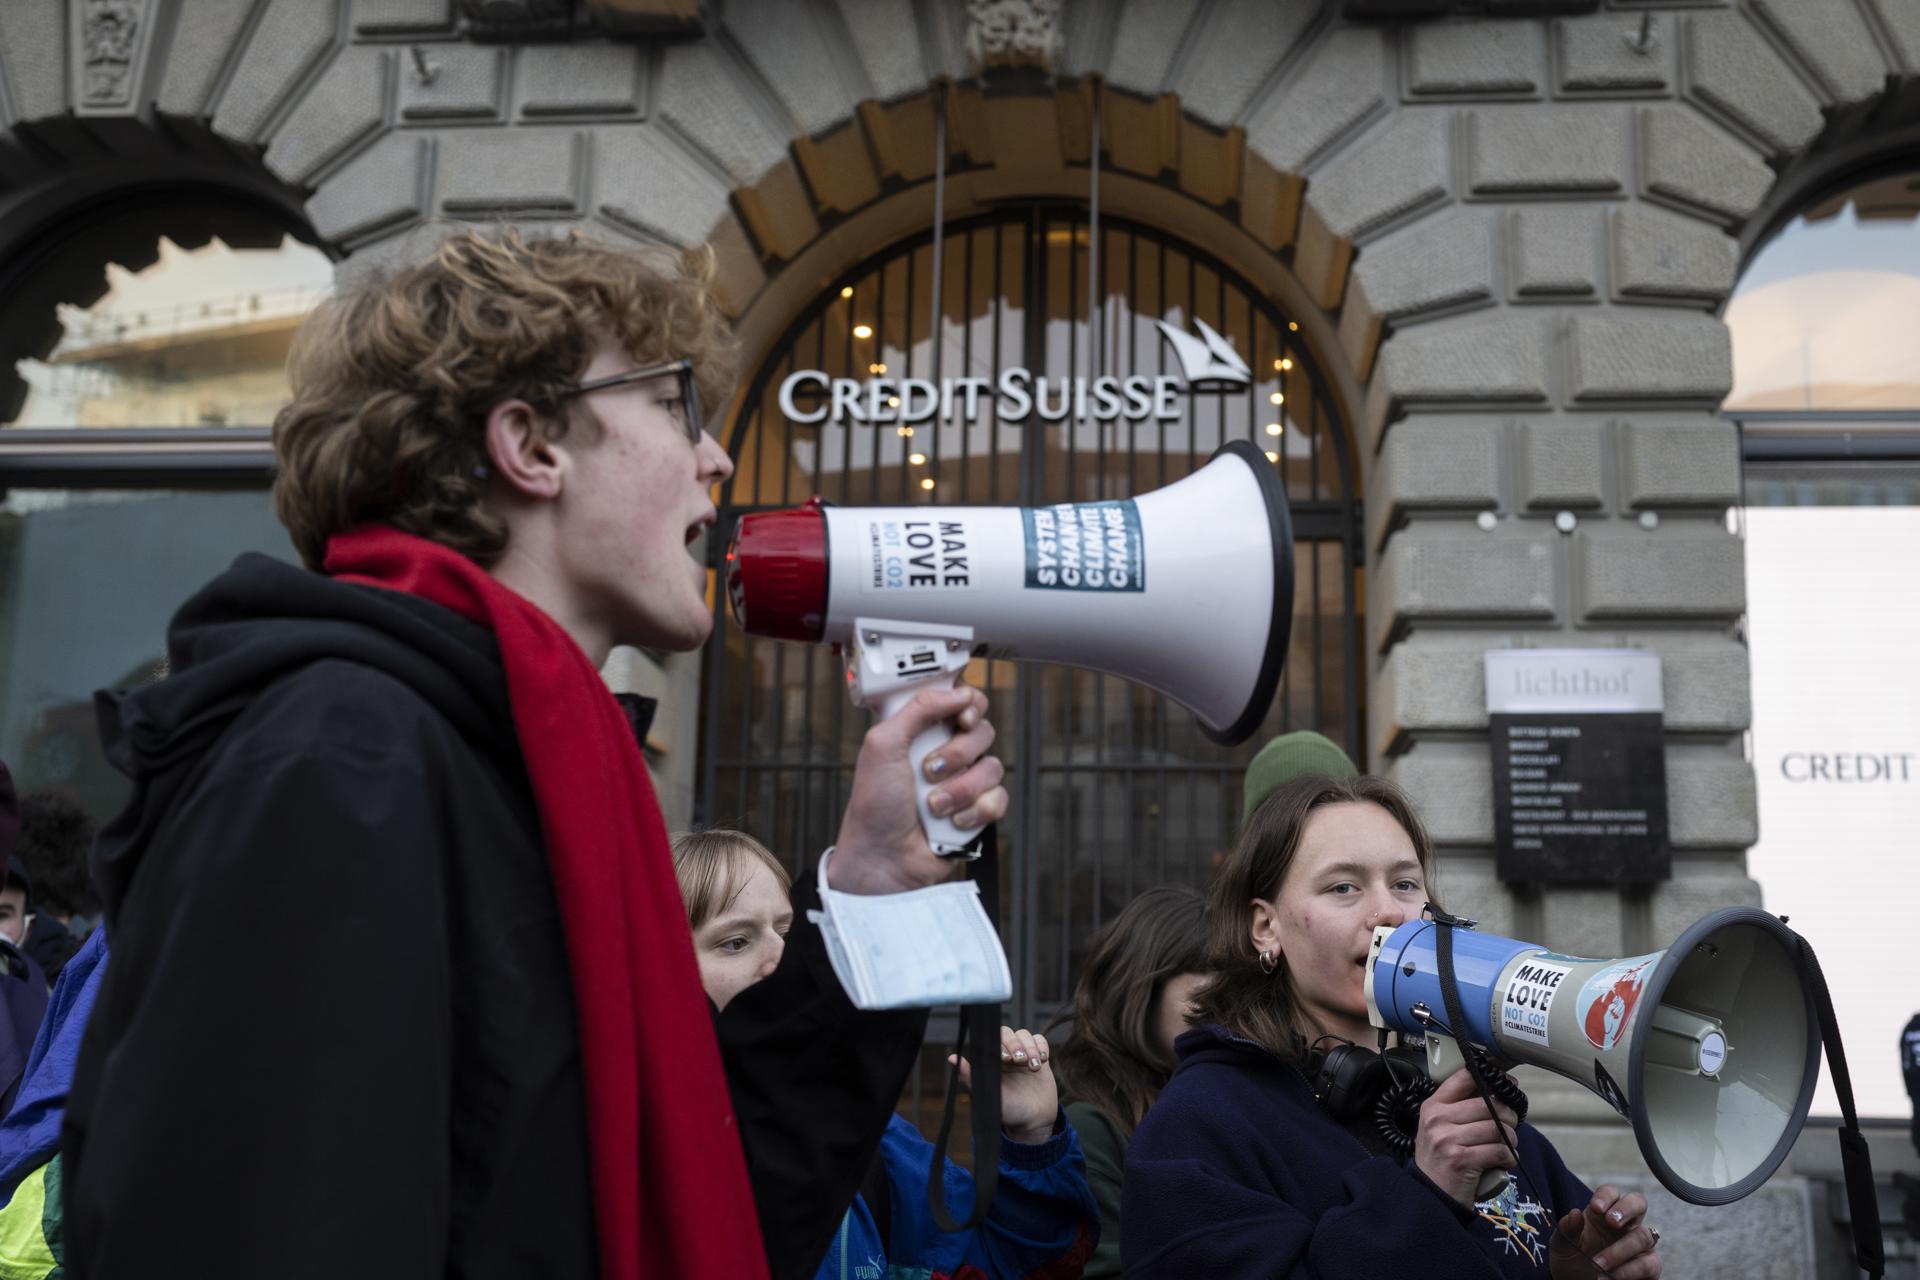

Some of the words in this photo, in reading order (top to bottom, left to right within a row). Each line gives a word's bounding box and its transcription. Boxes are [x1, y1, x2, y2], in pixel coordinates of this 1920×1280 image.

[883, 521, 901, 548] NOT
[1034, 510, 1056, 586] SYSTEM
[1080, 508, 1104, 587] CLIMATE
[1104, 507, 1128, 587] CHANGE
[905, 522, 936, 587] LOVE
[938, 522, 969, 587] MAKE
[886, 556, 904, 588] CO2
[1514, 666, 1634, 697] lichthof
[1781, 752, 1916, 783] CREDIT
[1515, 965, 1564, 988] MAKE
[1507, 983, 1552, 1011] LOVE
[1504, 1007, 1523, 1022] NOT
[1528, 1011, 1546, 1028] CO2
[1504, 1021, 1546, 1037] #CLIMATESTRIKE
